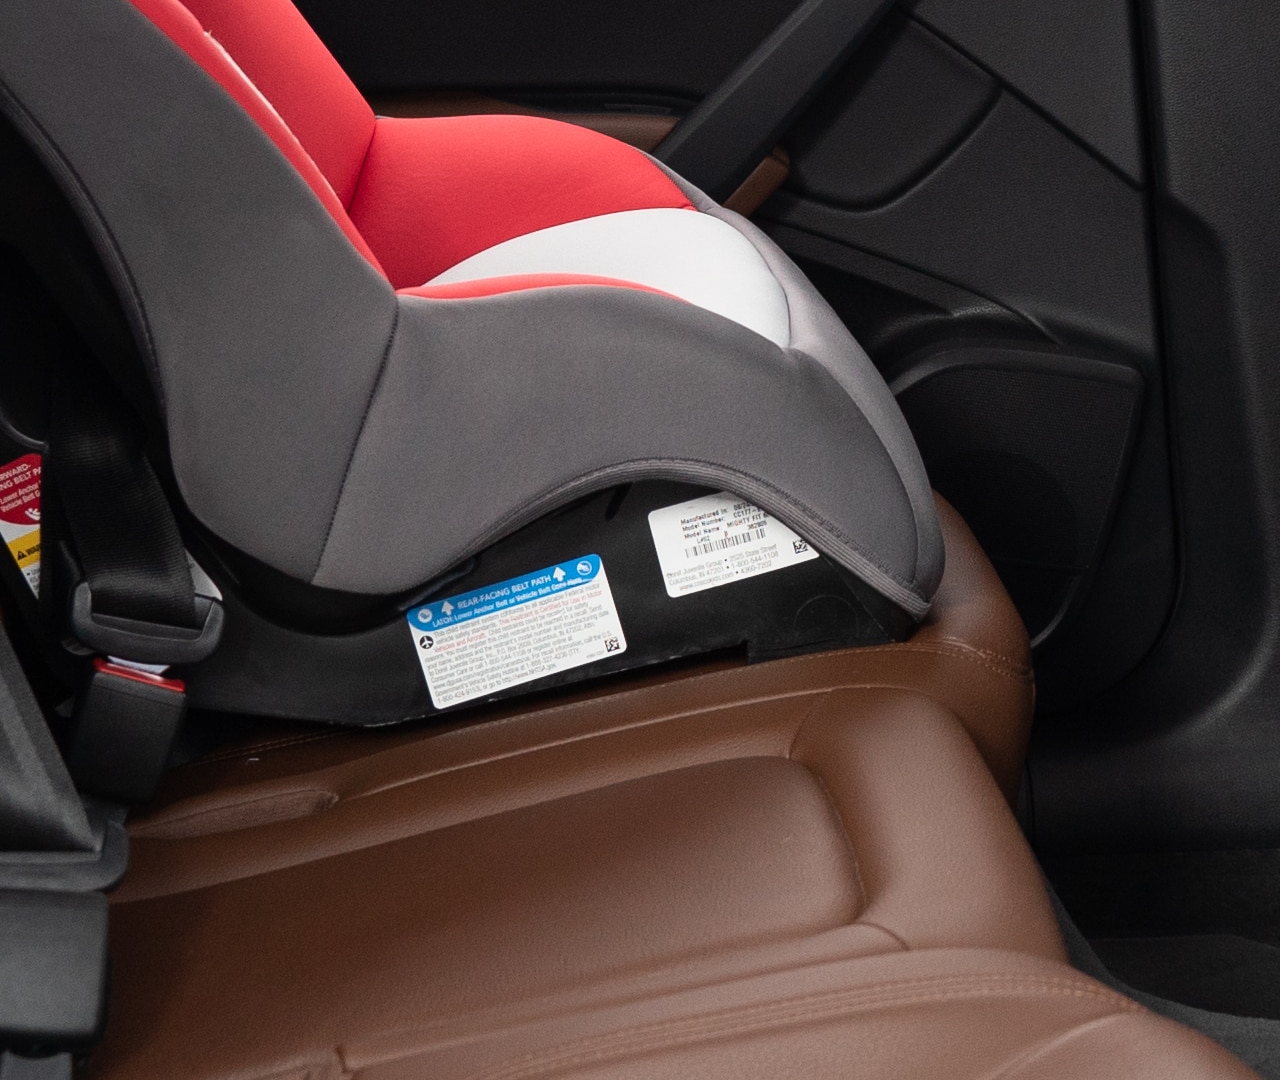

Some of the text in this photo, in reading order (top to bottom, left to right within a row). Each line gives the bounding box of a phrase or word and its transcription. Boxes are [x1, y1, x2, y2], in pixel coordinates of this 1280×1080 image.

[13, 471, 32, 484] BELT
[18, 481, 40, 496] Anchor
[0, 498, 23, 513] Vehicle
[22, 492, 36, 503] Belt
[680, 509, 719, 526] Manufactured
[682, 522, 700, 532] Model
[684, 530, 702, 540] Model
[727, 517, 750, 528] MIGHTY
[457, 575, 551, 609] REAR-FACING BELT PATH
[454, 610, 473, 621] Lower
[473, 603, 495, 615] Anchor
[496, 599, 508, 608] Belt
